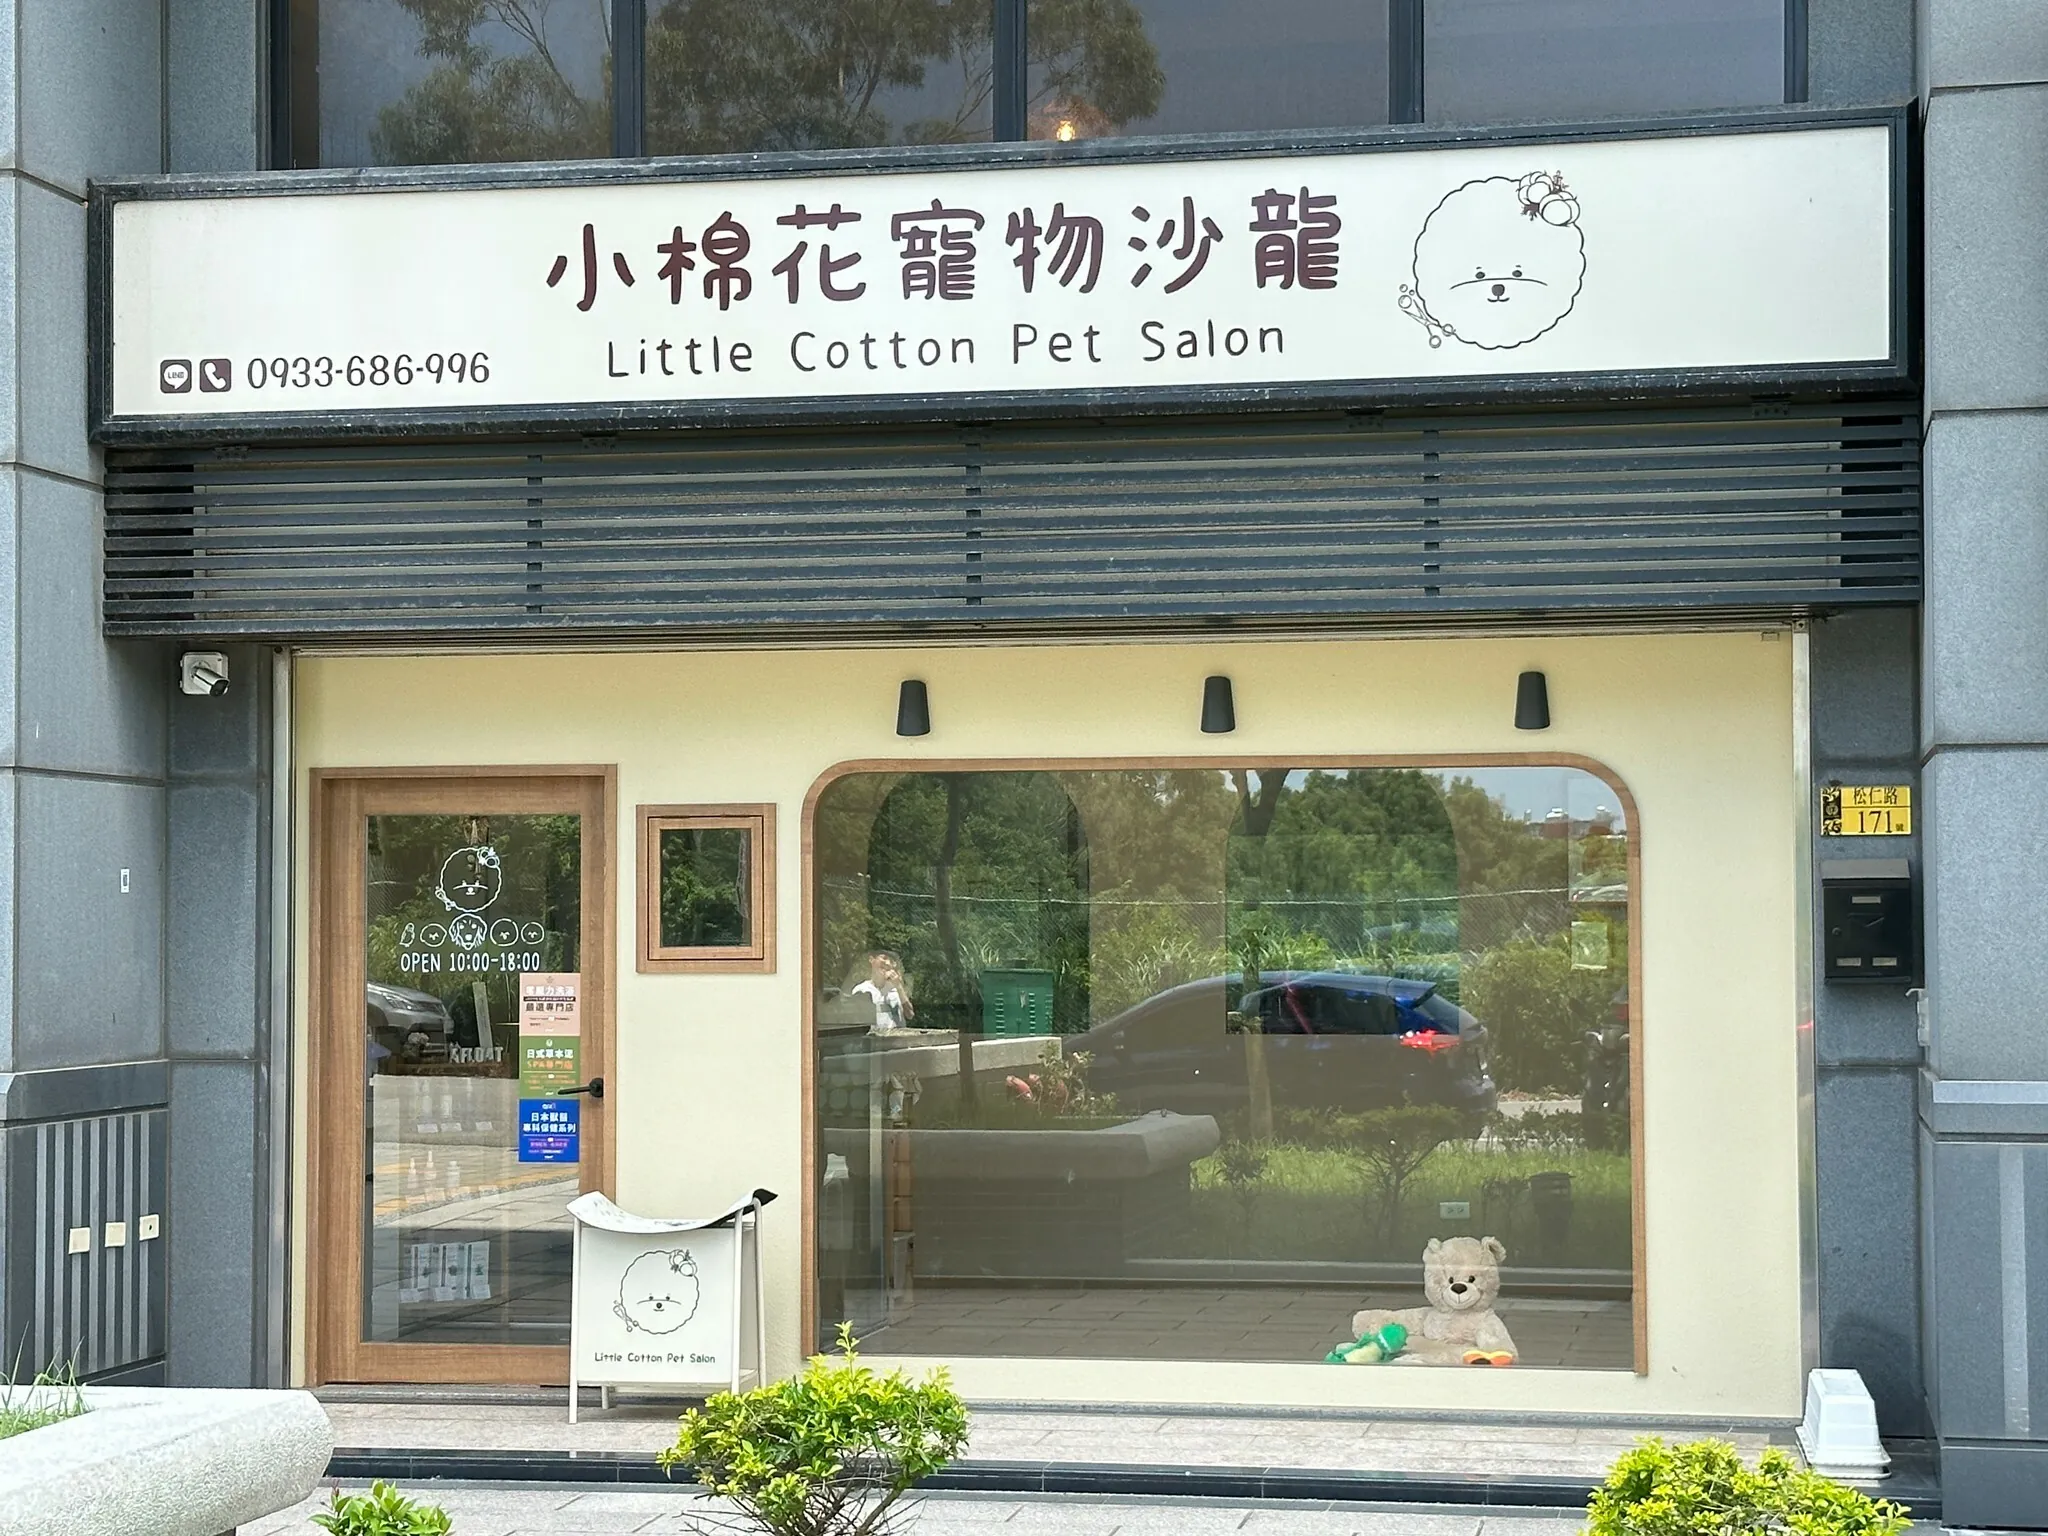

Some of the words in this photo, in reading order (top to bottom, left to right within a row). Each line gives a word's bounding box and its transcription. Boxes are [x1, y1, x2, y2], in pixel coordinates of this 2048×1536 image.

[546, 186, 1342, 312] 小棉花寵物沙龍
[607, 335, 753, 378] Little
[790, 330, 975, 372] Cotton
[1012, 322, 1102, 364] Pet
[1140, 319, 1284, 362] Salon
[247, 352, 490, 389] 0933-686-996
[1853, 786, 1897, 805] 松仁路
[1858, 810, 1892, 833] 171
[400, 952, 441, 973] OPEN
[449, 952, 540, 972] 10:00-18:00
[594, 1352, 623, 1362] Little
[627, 1352, 663, 1363] Cotton
[667, 1352, 684, 1363] Pet
[690, 1353, 716, 1363] Salon
